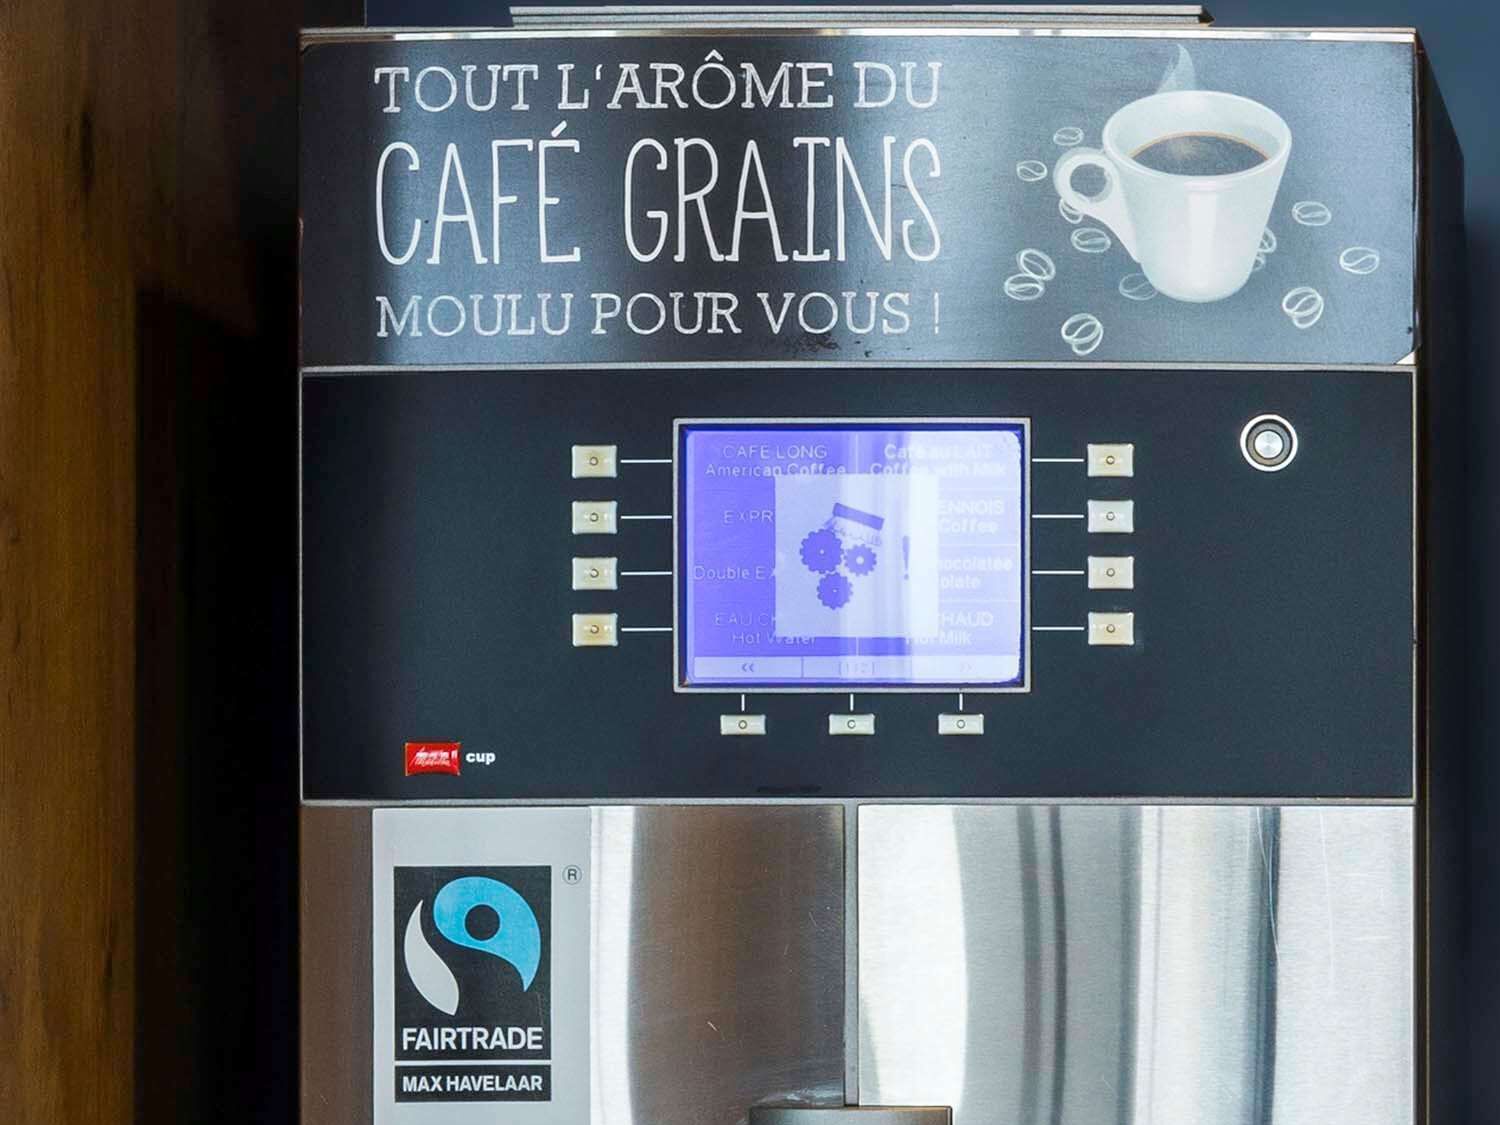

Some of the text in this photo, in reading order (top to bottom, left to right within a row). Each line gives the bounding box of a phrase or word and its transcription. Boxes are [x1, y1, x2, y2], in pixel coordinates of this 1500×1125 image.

[374, 63, 538, 113] TOUT
[853, 61, 941, 109] DU
[374, 120, 942, 266] CAFÉ GRAINS
[376, 291, 941, 338] MOULU POUR VOUS !
[775, 444, 828, 460] LONG
[704, 463, 846, 478] American Coffee
[941, 609, 994, 627] HAUD
[465, 751, 496, 766] cup
[402, 1026, 543, 1051] FAIRTRADE
[402, 1075, 543, 1092] MAX HAVELAAR
